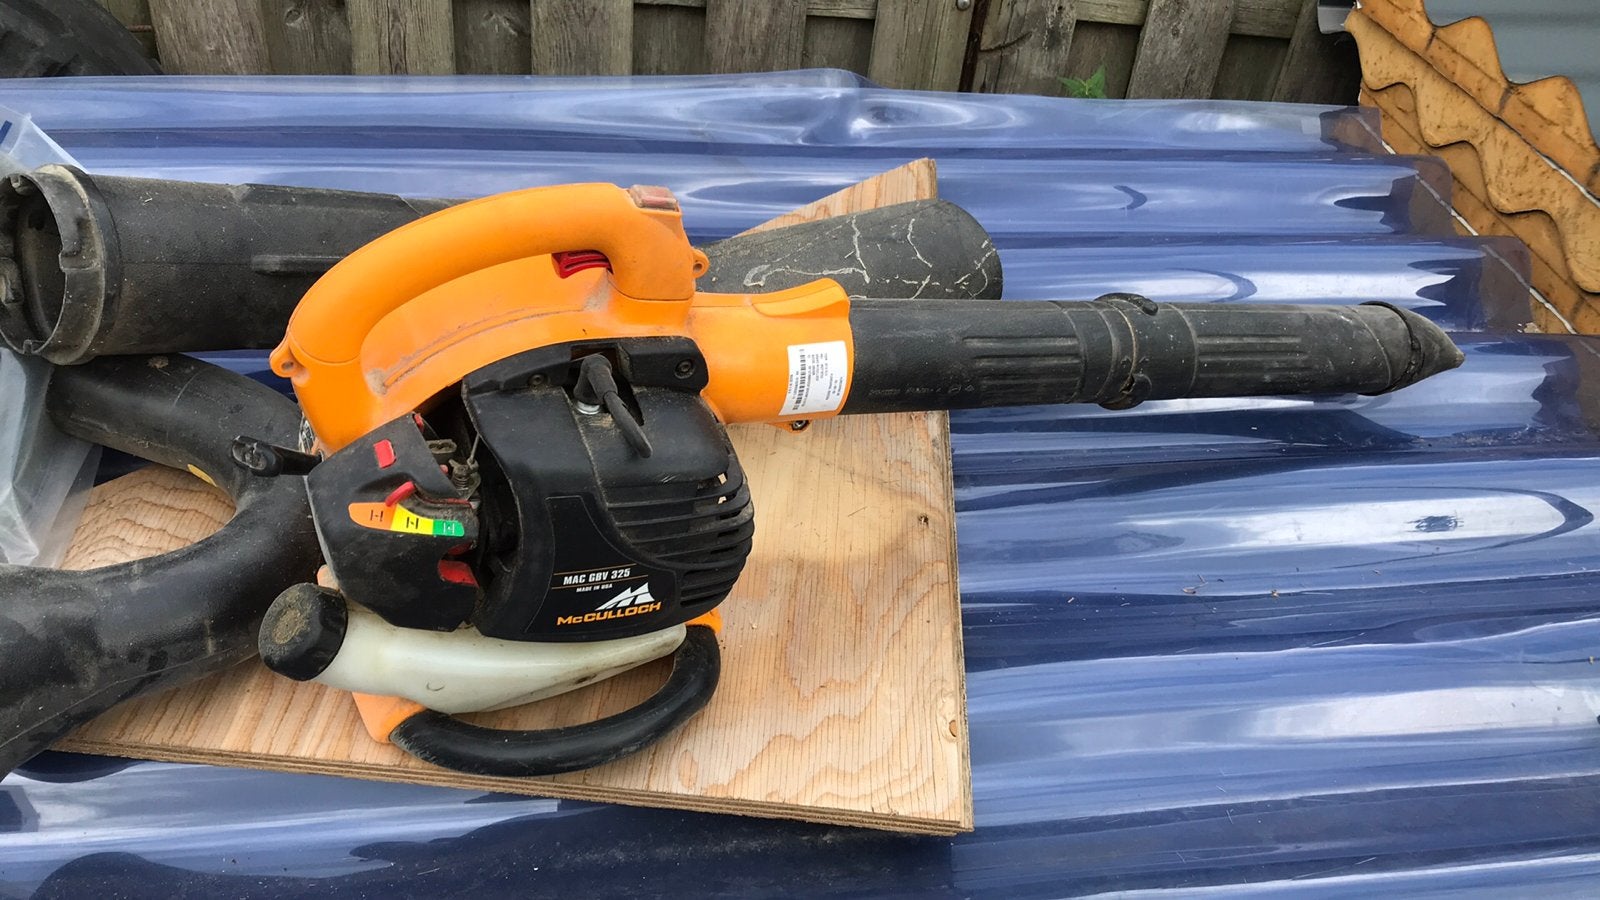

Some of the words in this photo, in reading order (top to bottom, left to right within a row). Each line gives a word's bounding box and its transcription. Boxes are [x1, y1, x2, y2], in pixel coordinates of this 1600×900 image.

[563, 574, 586, 585] MAC
[588, 571, 609, 582] GBV
[611, 568, 631, 579] 325
[557, 601, 662, 625] McCULLOCH
